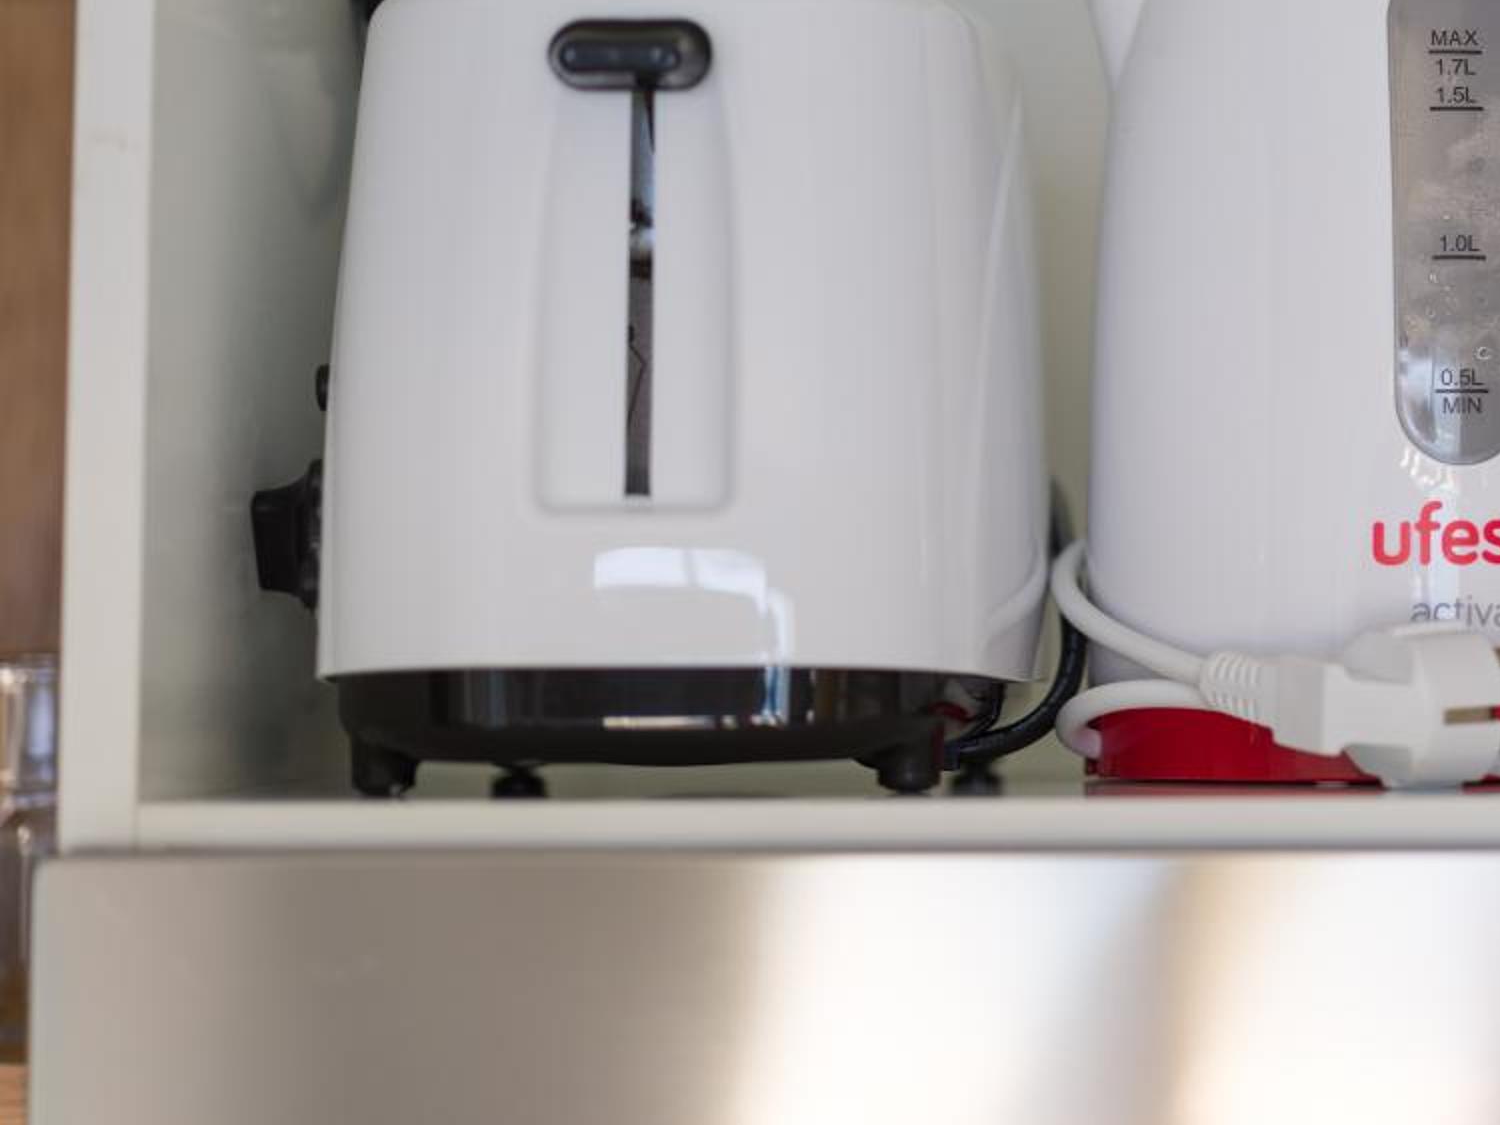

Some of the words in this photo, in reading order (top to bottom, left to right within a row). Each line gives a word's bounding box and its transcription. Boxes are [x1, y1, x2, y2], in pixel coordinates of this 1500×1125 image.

[1430, 29, 1479, 47] MAX
[1435, 58, 1477, 76] 1.7L
[1435, 86, 1477, 104] 1.5L
[1440, 234, 1481, 252] 1.0L
[1440, 368, 1485, 386] 0.5L
[1442, 397, 1483, 414] MIN
